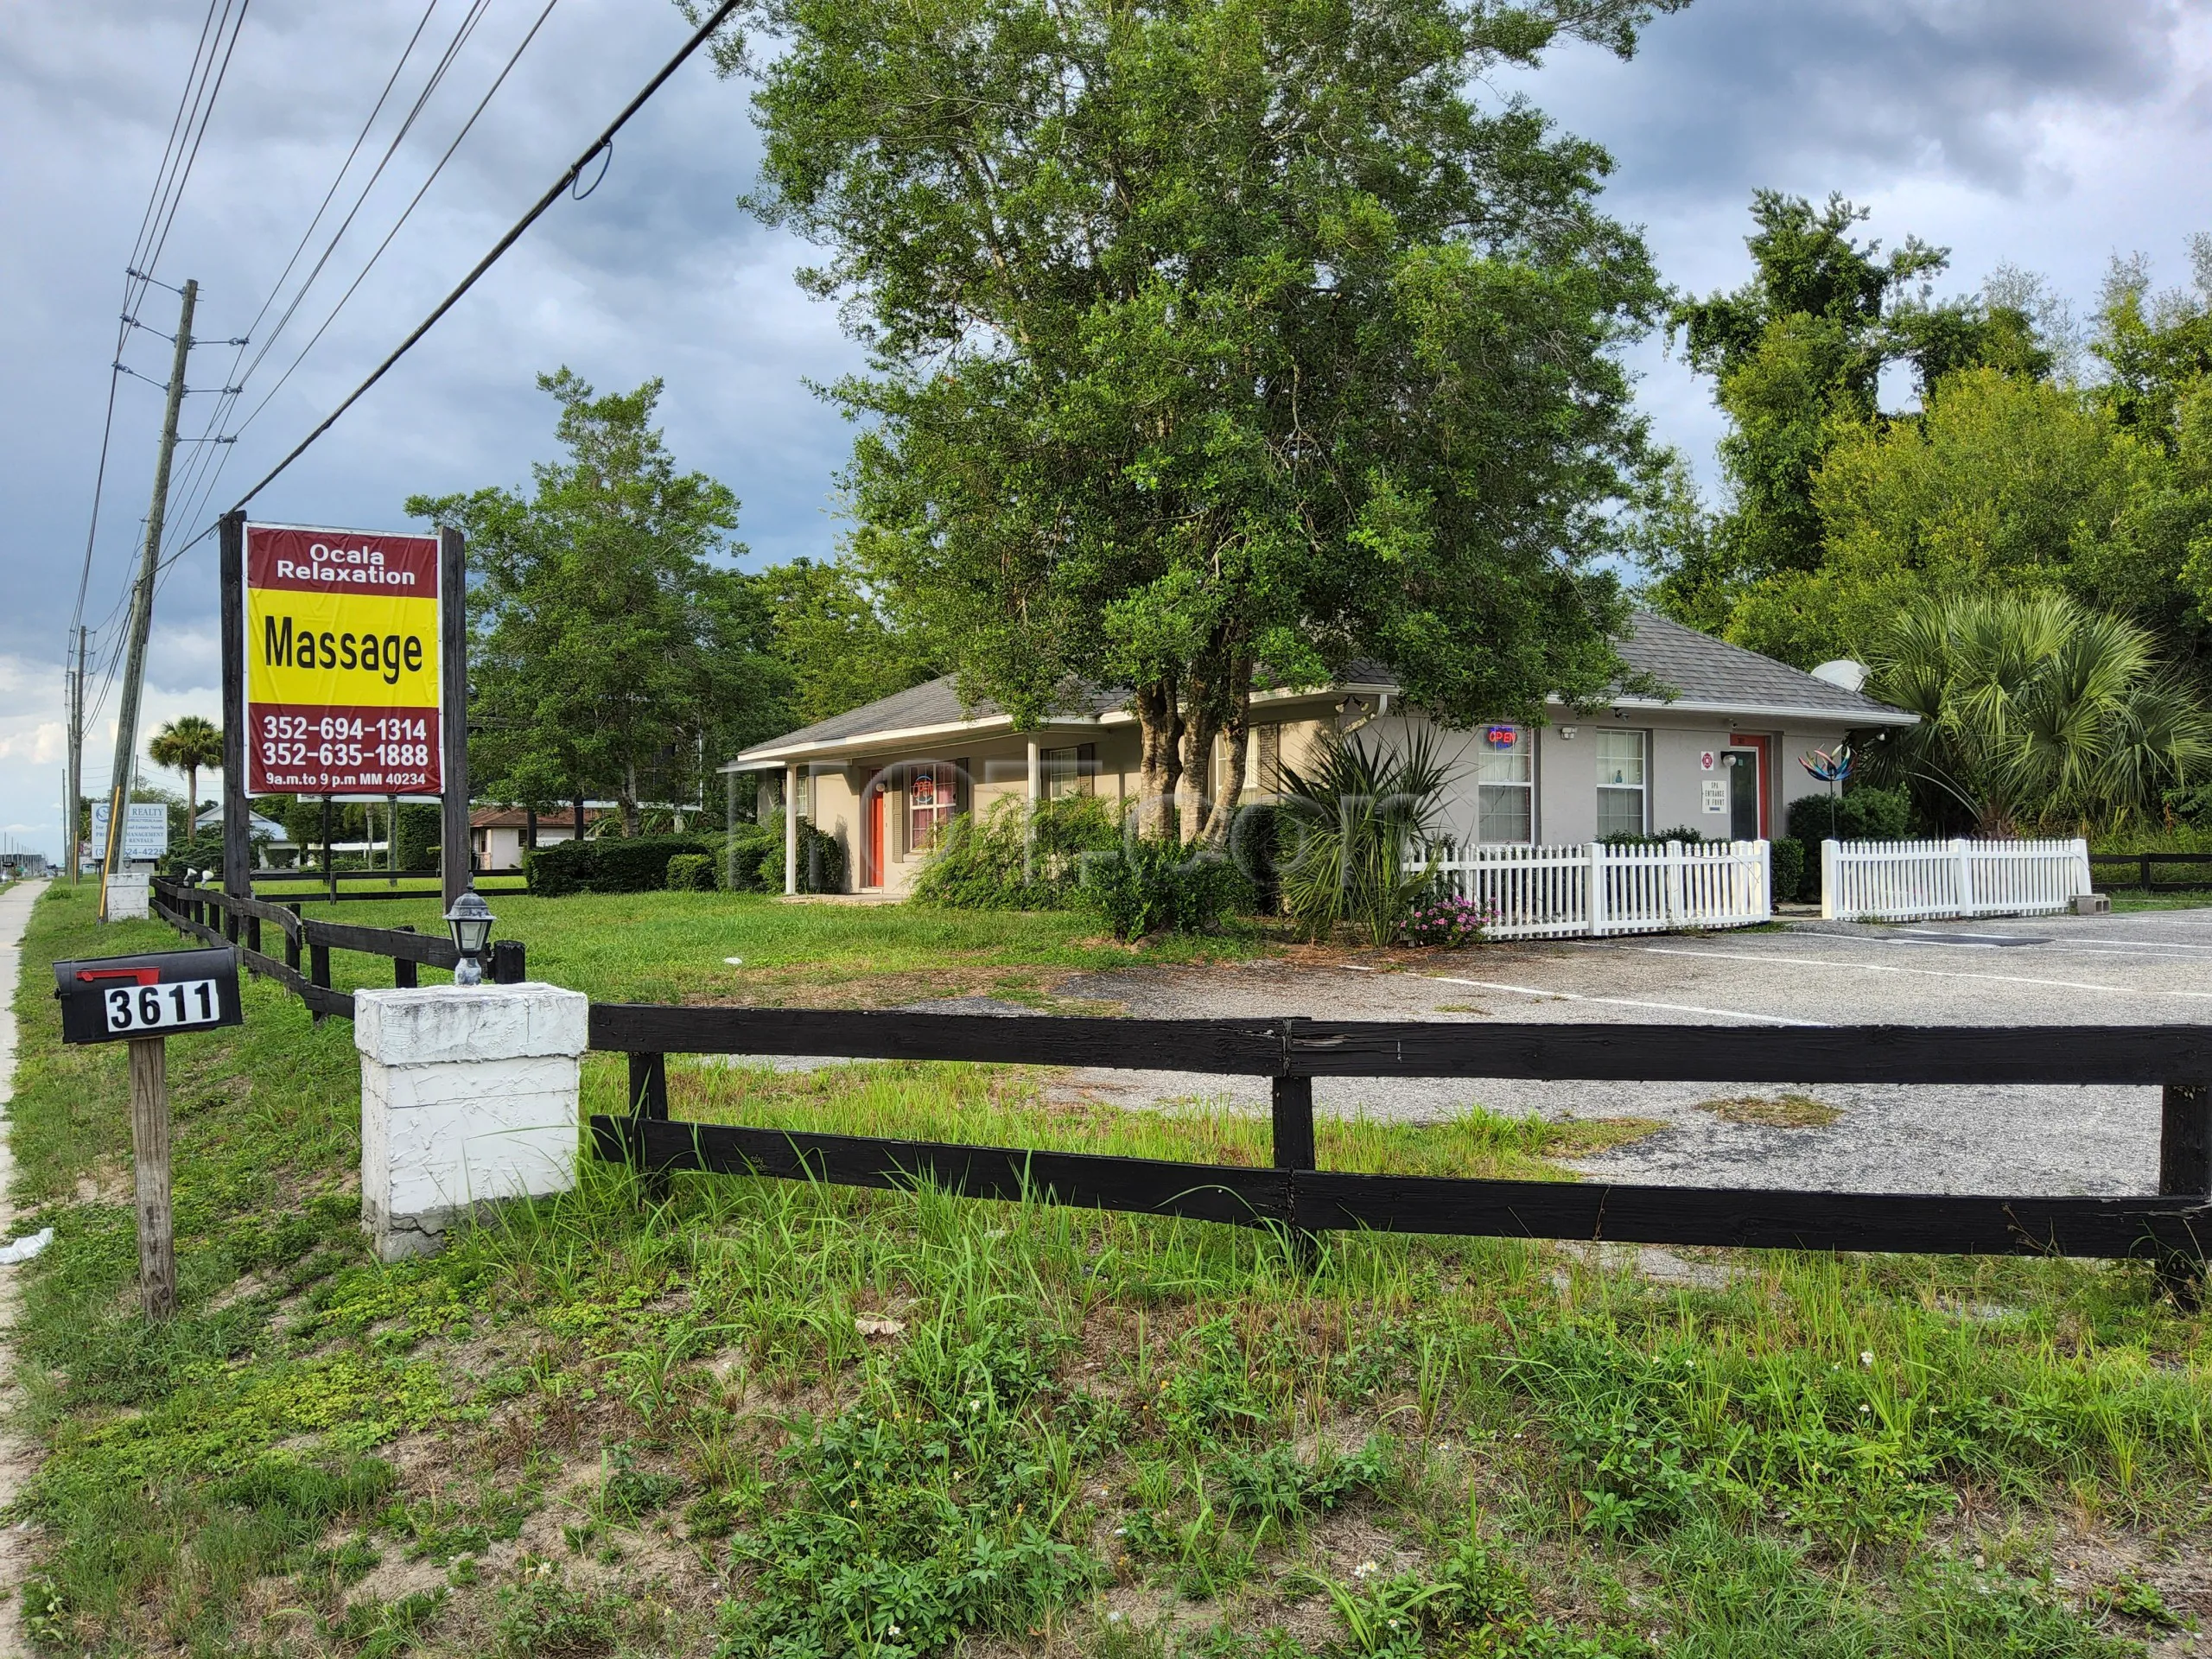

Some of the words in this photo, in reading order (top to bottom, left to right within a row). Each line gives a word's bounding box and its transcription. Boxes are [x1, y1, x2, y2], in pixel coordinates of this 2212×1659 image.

[309, 543, 385, 565] Ocala
[277, 560, 416, 585] Relaxation
[264, 615, 423, 684] Massage
[264, 715, 427, 741] 352-694-1314
[1489, 731, 1516, 743] OPEN
[262, 741, 429, 766] 352-635-1888
[320, 773, 328, 785] 9
[359, 773, 382, 785] MM
[385, 773, 426, 785] 40234
[913, 781, 933, 798] OPEN
[132, 808, 163, 817] REALTY
[109, 982, 212, 1029] 3611
